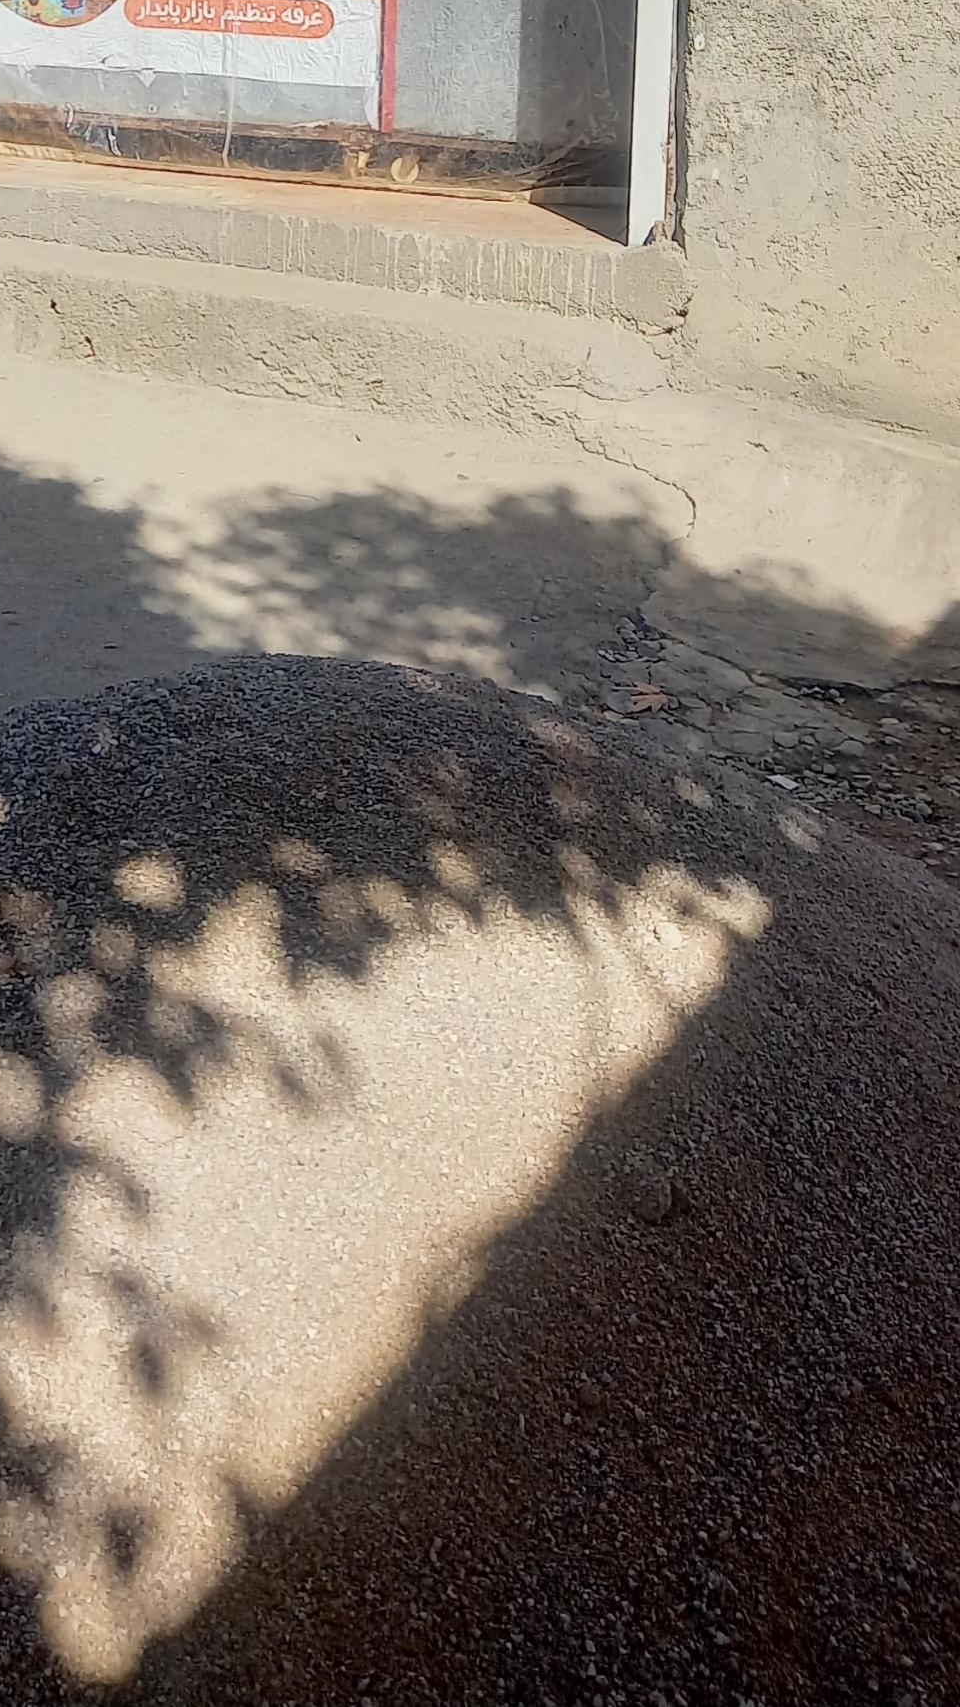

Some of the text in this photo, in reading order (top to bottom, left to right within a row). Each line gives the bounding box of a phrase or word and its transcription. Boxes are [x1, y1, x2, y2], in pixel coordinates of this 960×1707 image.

[182, 0, 216, 24] بازار
[220, 1, 276, 30] تنظیم
[280, 0, 324, 31] غرفه
